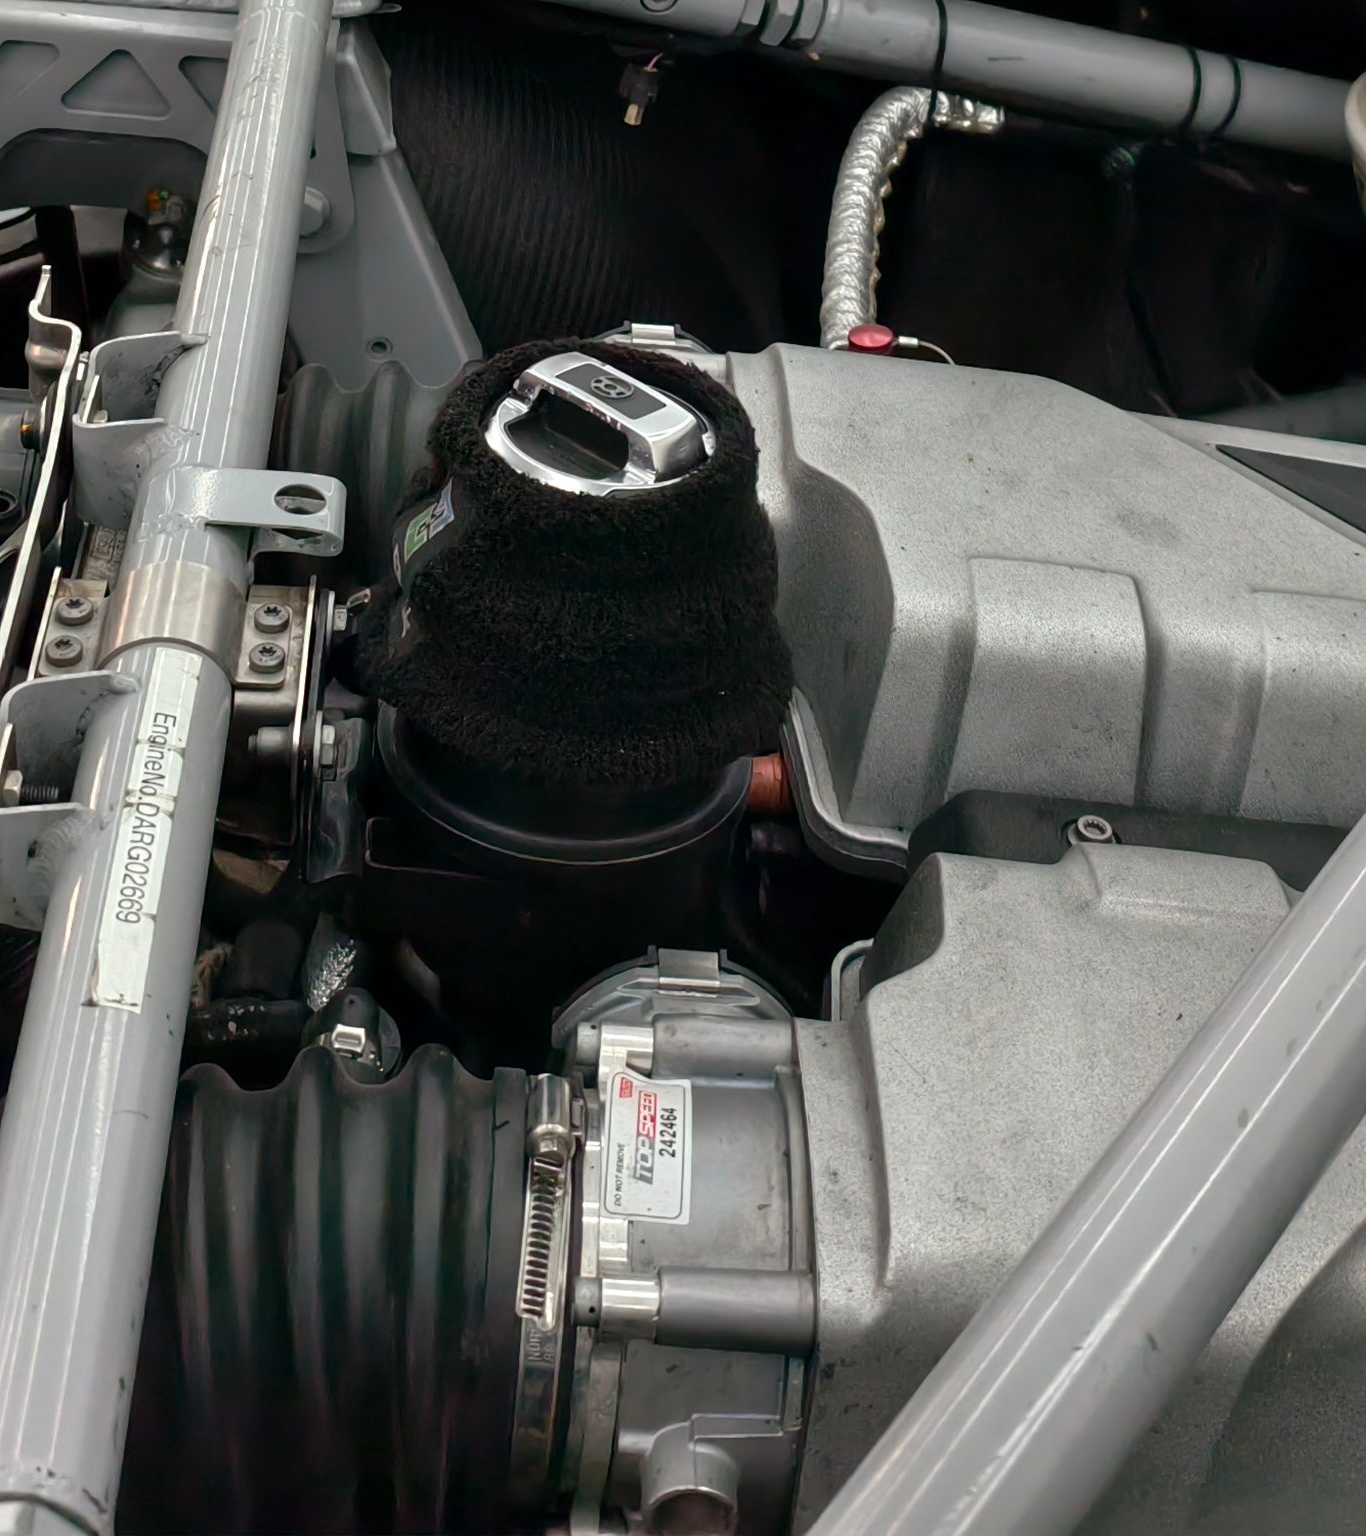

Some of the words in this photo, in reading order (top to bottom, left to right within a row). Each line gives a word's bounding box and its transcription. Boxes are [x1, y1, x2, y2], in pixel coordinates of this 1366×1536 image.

[659, 1107, 677, 1158] 242464
[616, 1143, 625, 1173] REMOVE
[615, 1174, 623, 1192] NOT
[614, 1193, 622, 1207] DO
